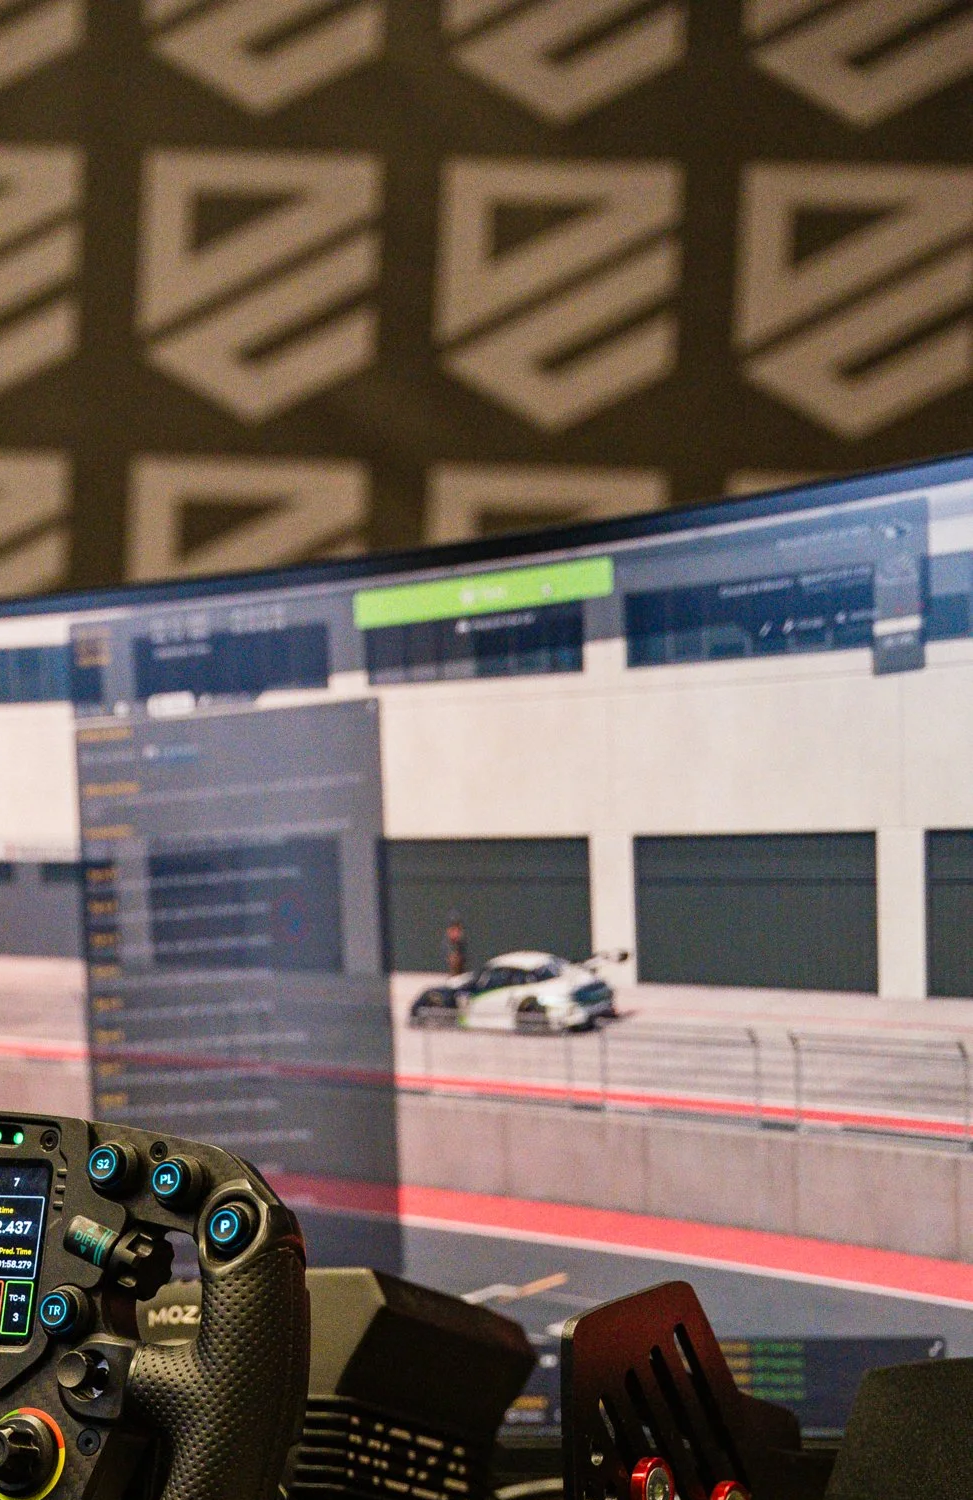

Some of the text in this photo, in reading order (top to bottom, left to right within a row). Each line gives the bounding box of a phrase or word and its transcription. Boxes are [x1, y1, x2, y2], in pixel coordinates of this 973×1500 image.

[96, 1159, 110, 1169] S2
[14, 1178, 20, 1187] 7
[160, 1174, 174, 1184] PL
[0, 1206, 14, 1214] time
[220, 1220, 230, 1232] P
[74, 1230, 97, 1247] DIFF
[48, 1304, 60, 1316] TR
[13, 1312, 19, 1322] 3
[147, 1305, 200, 1327] MOZ
